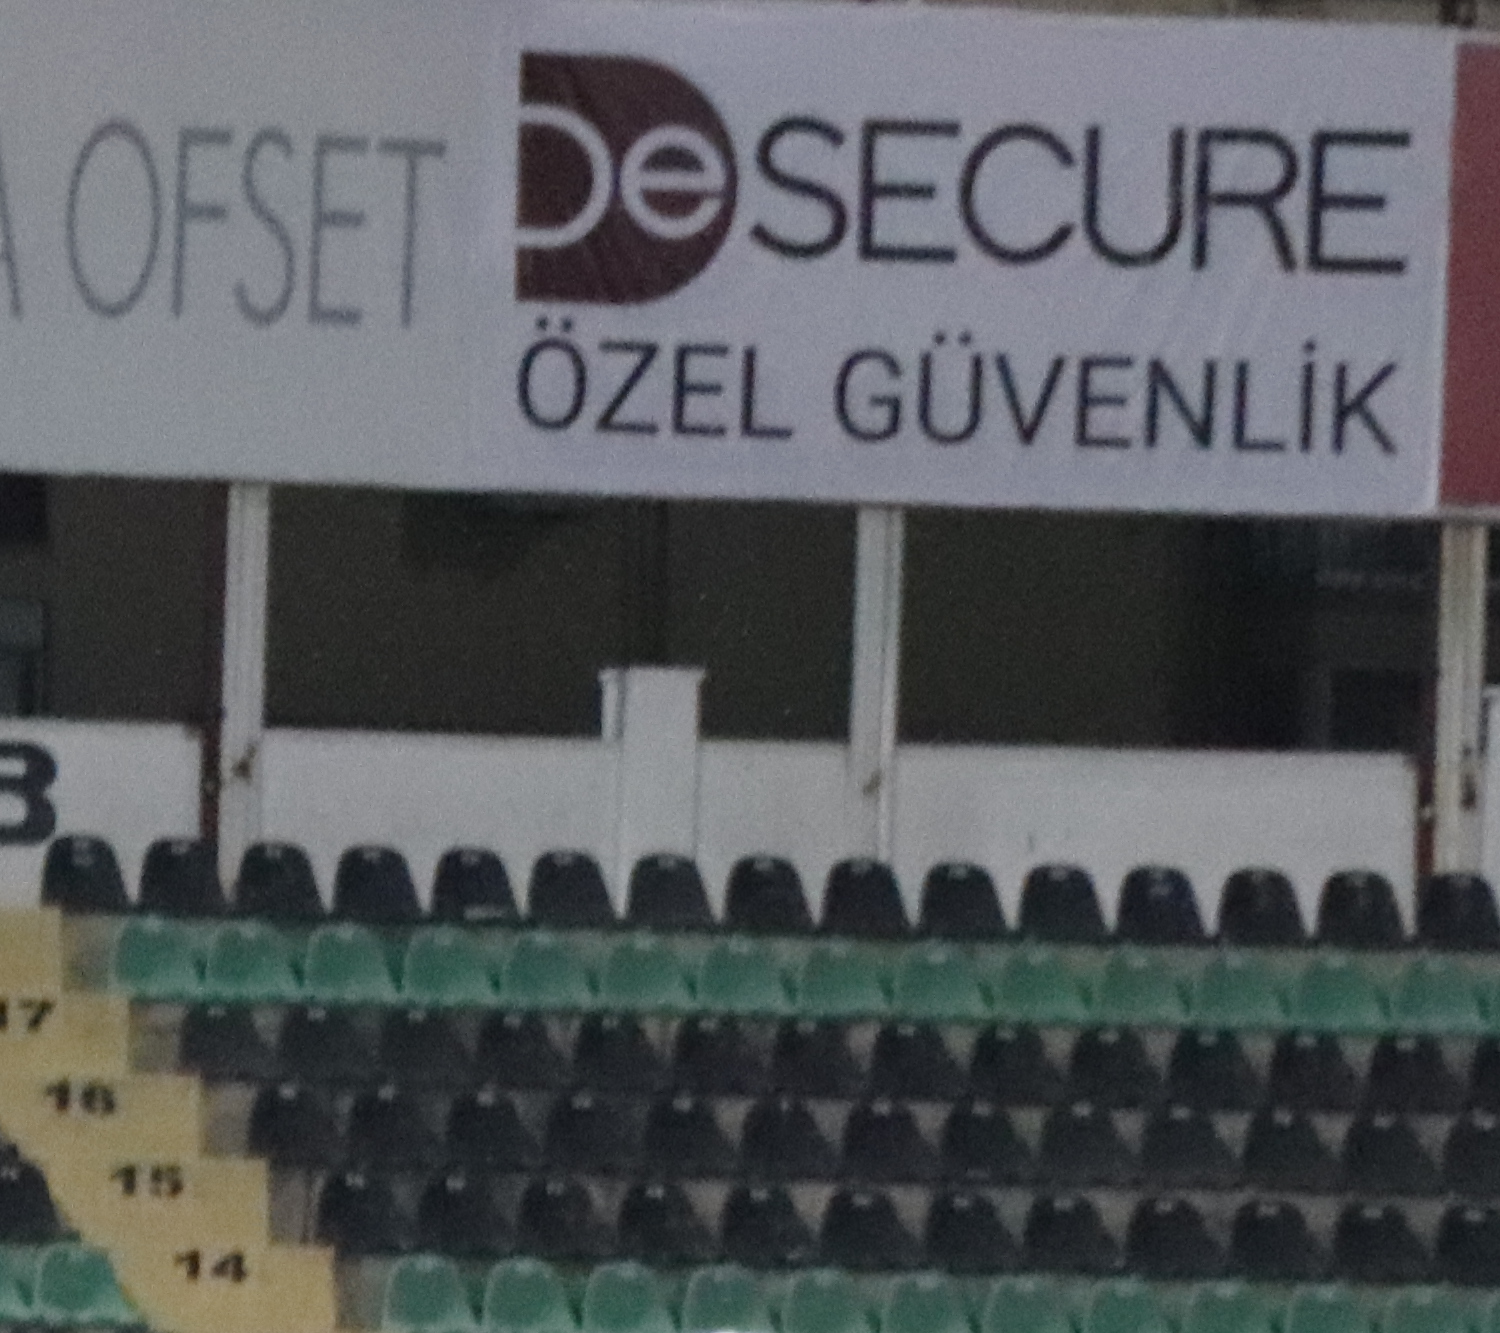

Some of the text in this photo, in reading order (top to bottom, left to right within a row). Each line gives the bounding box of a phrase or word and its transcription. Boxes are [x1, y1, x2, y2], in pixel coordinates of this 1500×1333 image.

[64, 118, 446, 330] OFSET
[517, 318, 1398, 456] ÖZEL GÜVENLİK
[43, 1075, 119, 1116] 16
[173, 1246, 250, 1284] 14
